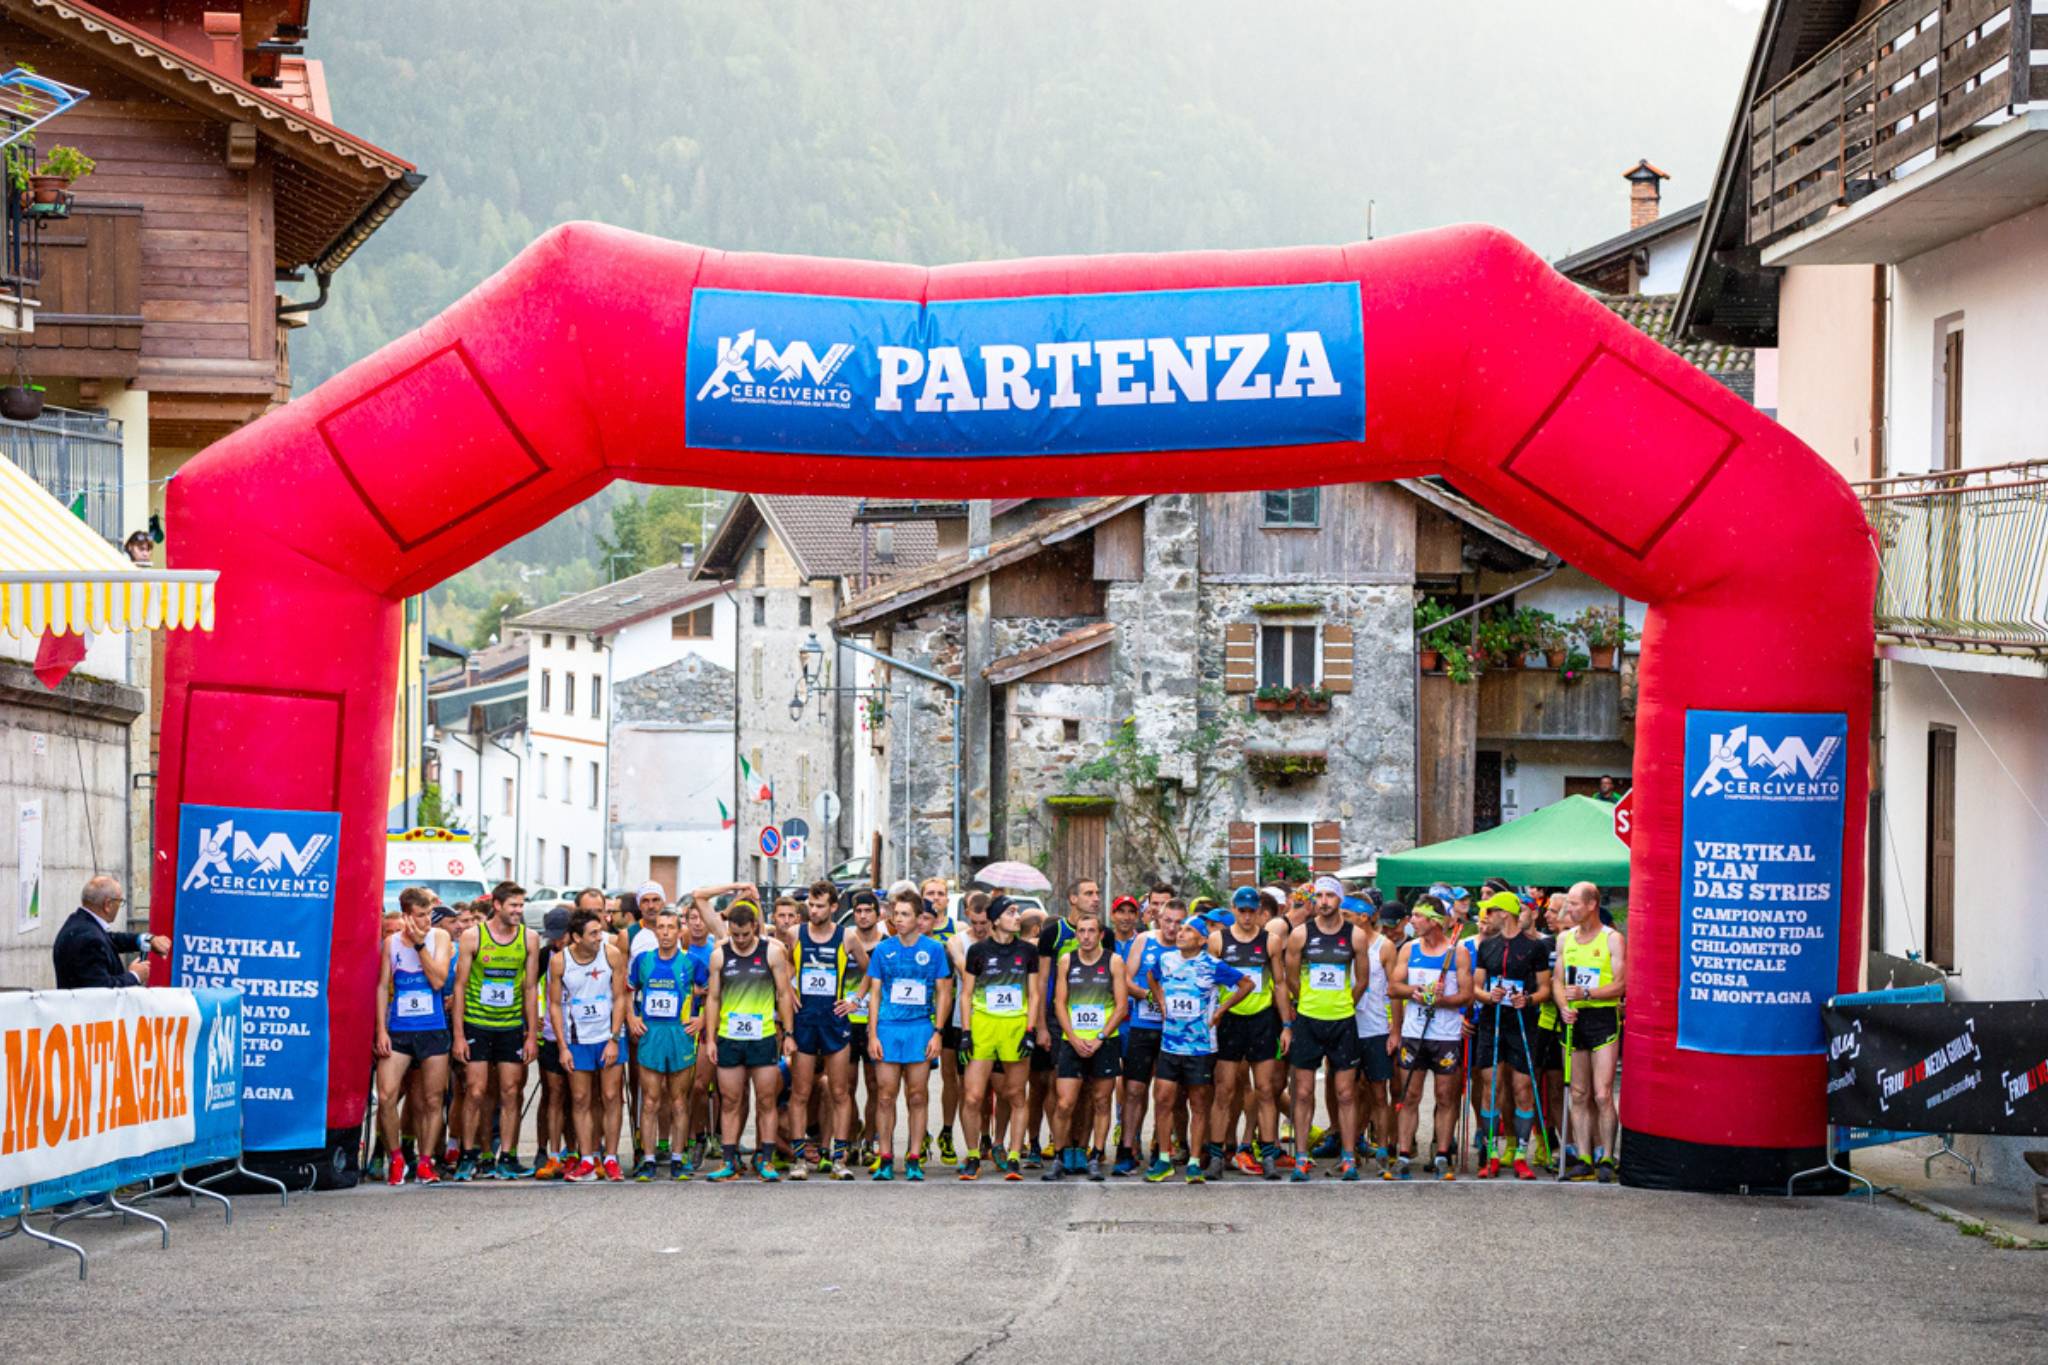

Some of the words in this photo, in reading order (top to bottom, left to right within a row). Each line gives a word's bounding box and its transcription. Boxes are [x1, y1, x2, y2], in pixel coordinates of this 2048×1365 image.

[875, 330, 1342, 413] PARTENZA
[731, 384, 851, 402] CERCIVENTO
[1724, 780, 1839, 795] CERCIVENTO
[1694, 841, 1816, 863] VERTIKAL
[1694, 861, 1759, 881] PLAN
[210, 875, 329, 892] CERCIVENTO
[1693, 882, 1744, 900] DAS
[1749, 883, 1831, 902] STRIES
[1692, 906, 1807, 923] CAMPIONATO
[1691, 922, 1776, 940] ITALIANO
[1779, 922, 1824, 939] FIDAL
[182, 934, 301, 959] VERTIKAL
[1691, 939, 1802, 956] CHILOMETRO
[181, 955, 240, 975] PLAN
[1690, 955, 1787, 972] VERTICALE
[181, 974, 225, 990] DAS
[231, 978, 319, 998] STRIES
[810, 976, 826, 987] 20
[1319, 972, 1336, 983] 22
[1577, 974, 1592, 985] 57
[1690, 971, 1749, 988] CORSA
[904, 987, 912, 997] 7
[997, 993, 1012, 1004] 24
[1690, 987, 1709, 1002] IN
[1712, 988, 1813, 1005] MONTAGNA
[411, 998, 418, 1009] 8
[583, 1004, 597, 1015] 31
[651, 999, 671, 1009] 143
[1172, 999, 1192, 1010] 144
[1077, 1012, 1098, 1022] 102
[260, 1022, 311, 1036] FIDAL
[736, 1021, 752, 1032] 26
[1883, 1066, 1912, 1099] FRIULI
[1946, 1032, 1975, 1064] GIULIA
[1, 1016, 190, 1155] MONTAGNA
